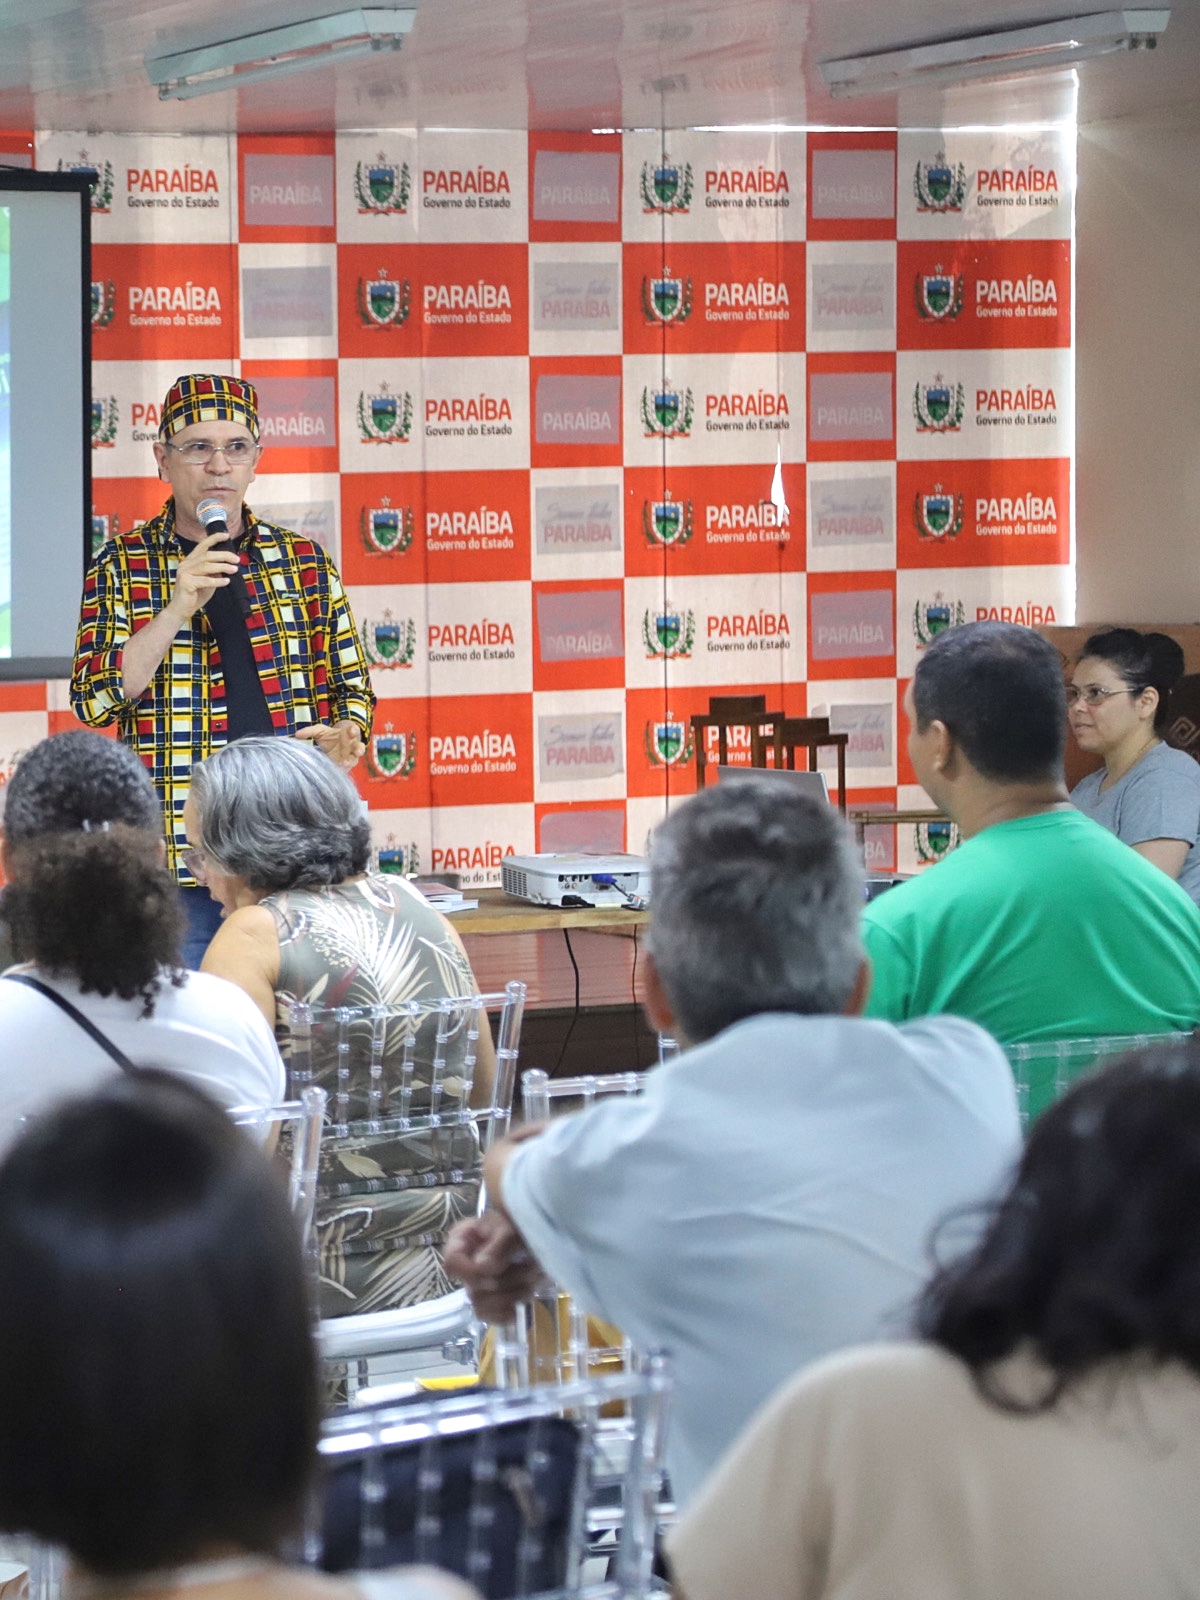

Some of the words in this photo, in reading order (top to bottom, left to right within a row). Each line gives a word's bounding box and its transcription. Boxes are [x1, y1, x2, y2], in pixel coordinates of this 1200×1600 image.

[127, 163, 219, 193] PARAÍBA
[423, 165, 511, 194] PARAÍBA
[705, 165, 790, 193] PARAÍBA
[977, 164, 1058, 192] PARAÍBA
[127, 196, 169, 208] Governo
[171, 196, 184, 208] do
[185, 196, 220, 208] Estado
[423, 197, 463, 209] Governo
[465, 196, 477, 208] do
[478, 196, 511, 209] Estado
[705, 197, 743, 209] Governo
[745, 196, 757, 208] do
[758, 196, 790, 208] Estado
[977, 195, 1014, 207] Governo
[1016, 195, 1027, 206] do
[1028, 195, 1059, 206] Estado
[128, 281, 221, 311] PARAÍBA
[423, 279, 512, 309] PARAÍBA
[705, 277, 790, 307] PARAÍBA
[976, 274, 1058, 303] PARAÍBA
[130, 314, 171, 326] Governo
[173, 314, 186, 326] do
[187, 313, 222, 326] Estado
[424, 312, 464, 324] Governo
[465, 312, 478, 323] do
[478, 311, 512, 323] Estado
[705, 310, 743, 322] Governo
[745, 309, 757, 321] do
[758, 308, 790, 320] Estado
[976, 306, 1013, 318] Governo
[1015, 306, 1026, 317] do
[1027, 305, 1058, 317] Estado
[426, 393, 512, 422] PARAÍBA
[706, 389, 790, 416] PARAÍBA
[976, 384, 1057, 411] PARAÍBA
[426, 424, 465, 436] Governo
[466, 424, 479, 435] do
[480, 424, 513, 436] Estado
[542, 407, 612, 431] PARAÍBA
[706, 420, 744, 432] Governo
[746, 420, 757, 431] do
[759, 419, 790, 431] Estado
[976, 415, 1013, 426] Governo
[1014, 414, 1026, 425] do
[1027, 414, 1057, 425] Estado
[132, 430, 158, 441] Gove
[706, 500, 790, 529] PARAÍBA
[976, 492, 1057, 521] PARAÍBA
[426, 505, 514, 536] PARAÍBA
[543, 520, 612, 544] PARAÍBA
[976, 524, 1013, 536] Governo
[1014, 523, 1026, 535] do
[1027, 522, 1057, 535] Estado
[427, 538, 467, 551] Governo
[468, 538, 480, 550] do
[481, 537, 514, 550] Estado
[706, 531, 744, 543] Governo
[746, 531, 758, 542] do
[759, 530, 790, 542] Estado
[707, 609, 790, 637] PARAÍBA
[976, 601, 1056, 626] PARAÍBA
[428, 618, 515, 648] PARAÍBA
[428, 651, 467, 662] Governo
[469, 650, 482, 661] do
[483, 649, 515, 661] Estado
[707, 641, 745, 652] Governo
[747, 640, 758, 651] do
[760, 639, 790, 651] Estado
[430, 729, 516, 760] PARAÍBA
[430, 763, 470, 775] Governo
[471, 762, 483, 774] do
[484, 761, 516, 773] Estado
